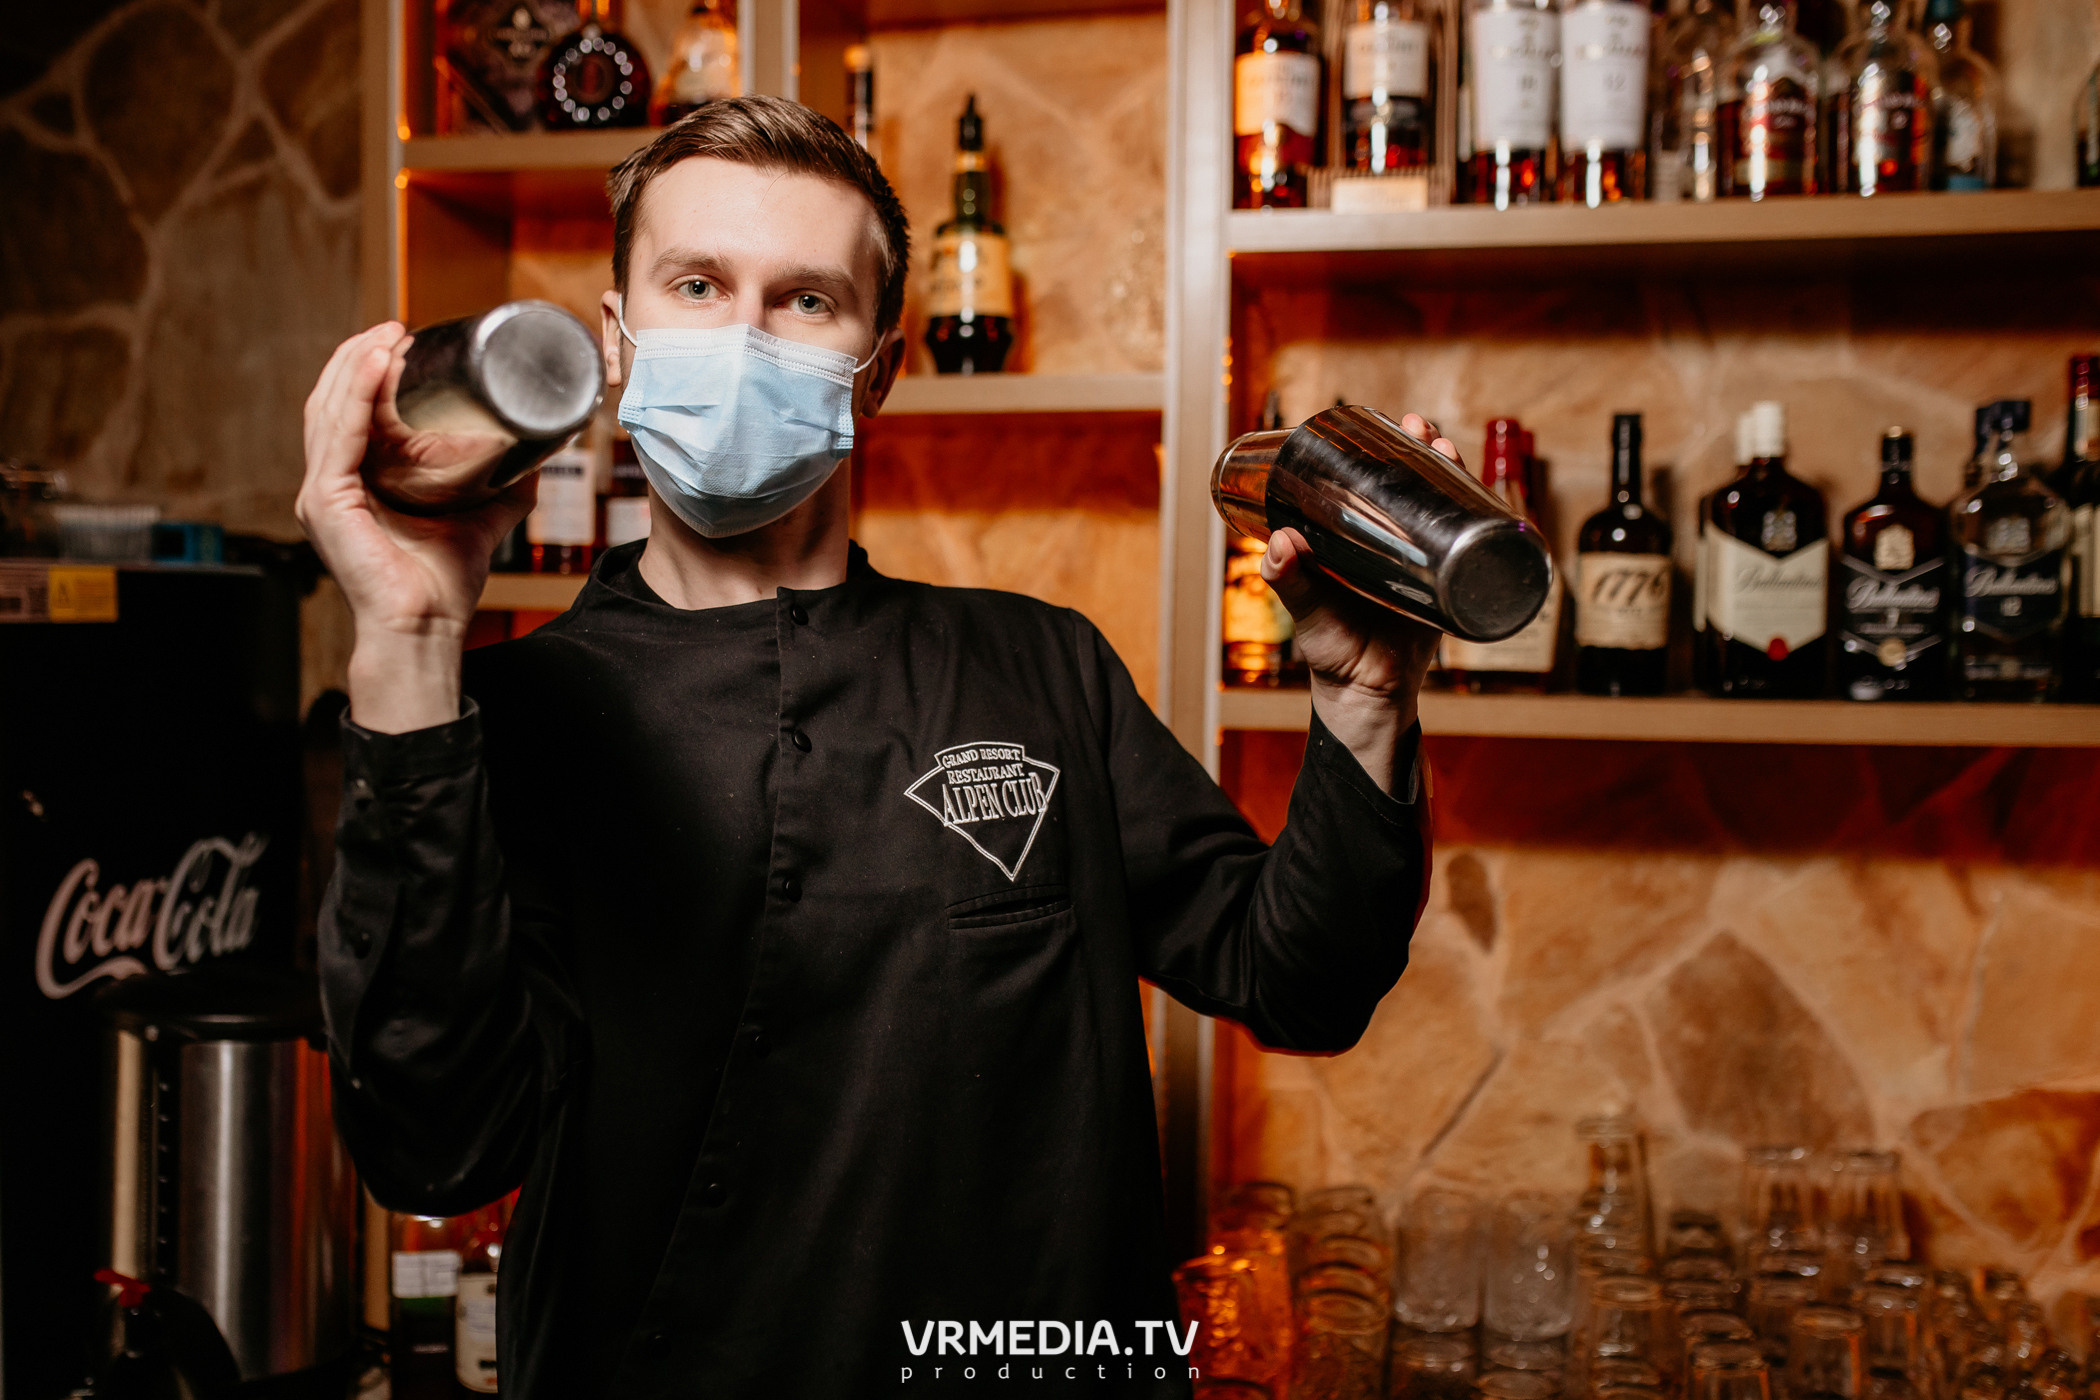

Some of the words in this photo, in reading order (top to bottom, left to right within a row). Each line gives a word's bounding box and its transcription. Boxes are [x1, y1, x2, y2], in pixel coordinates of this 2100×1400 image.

[942, 749, 979, 769] GRAND
[979, 748, 1021, 761] RESORT
[946, 763, 1025, 785] RESTAURANT
[942, 782, 1005, 827] ALPEN
[1002, 772, 1048, 818] CLUB
